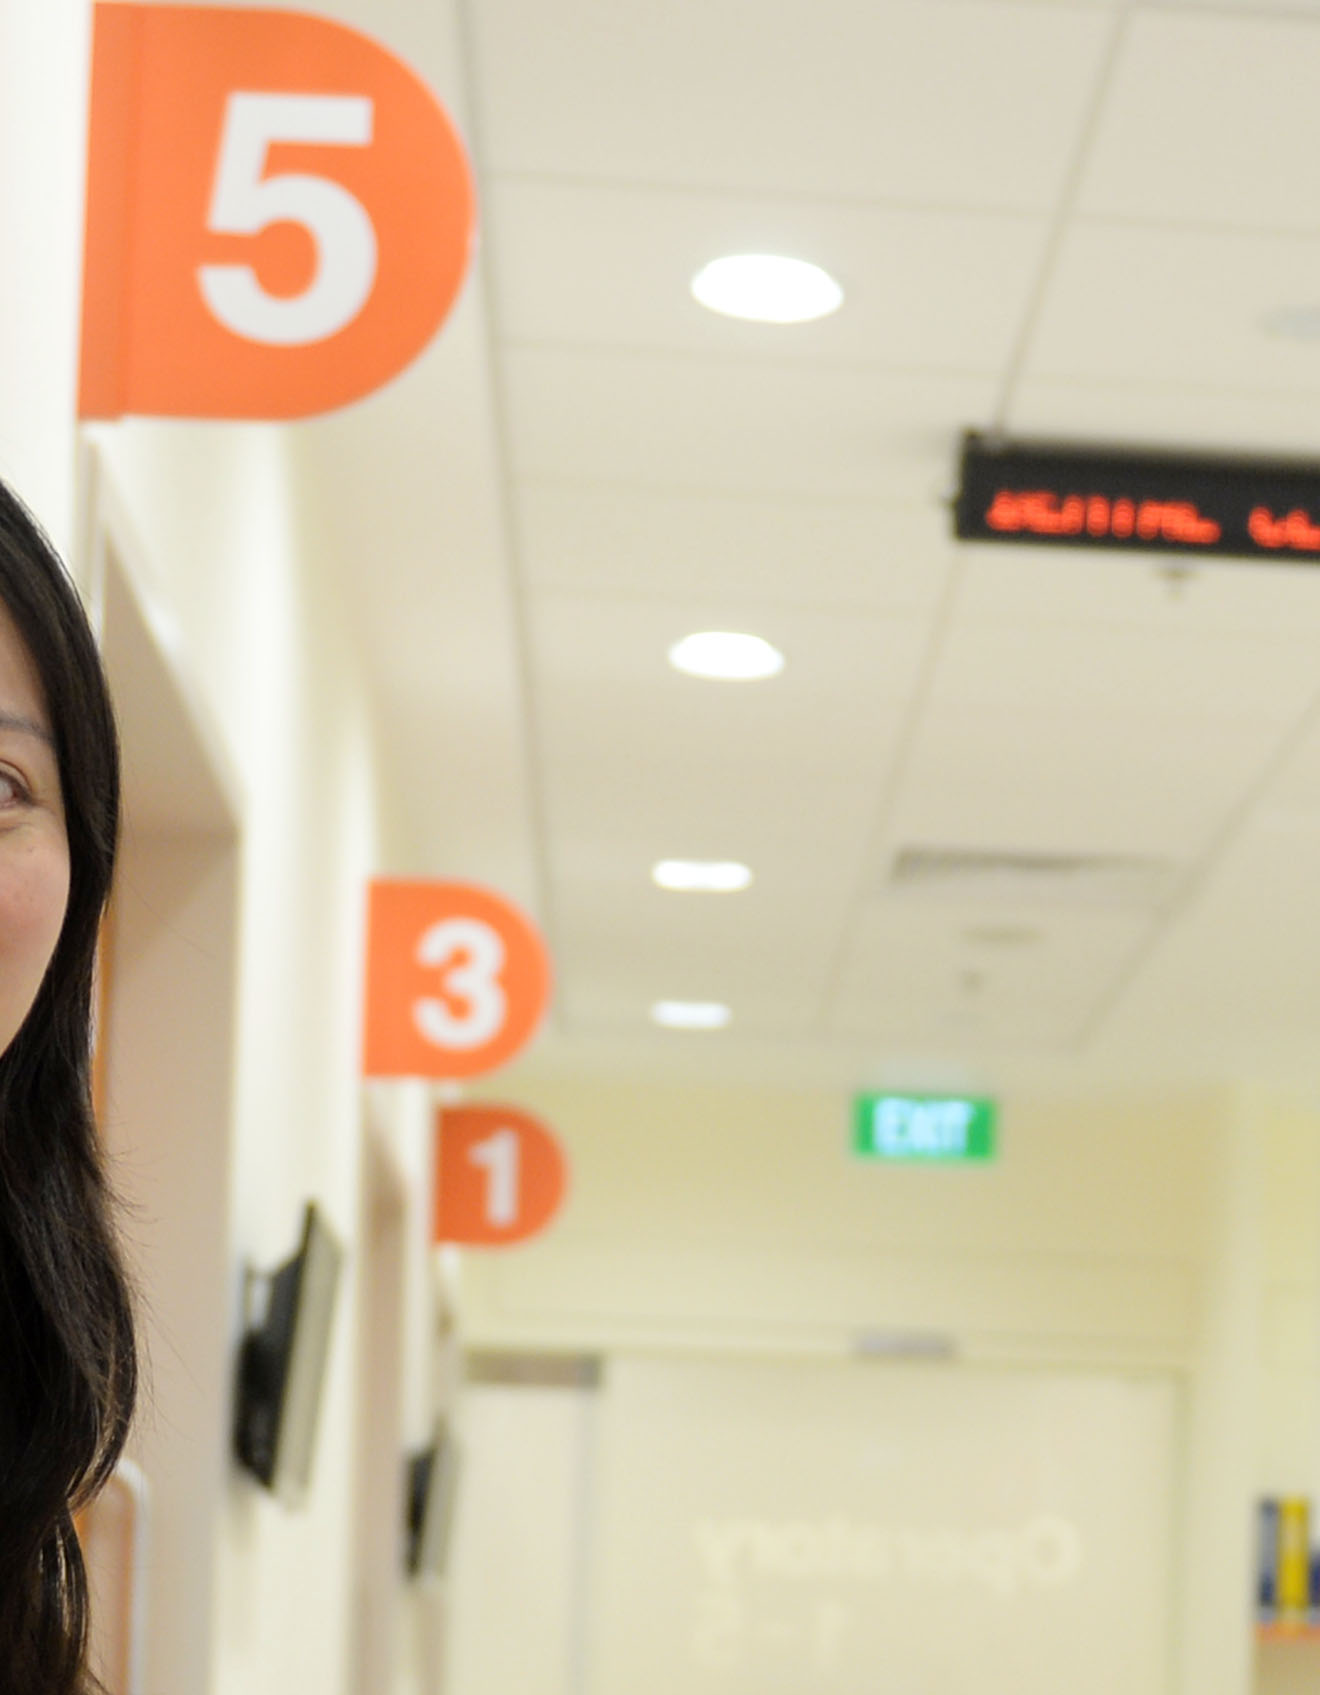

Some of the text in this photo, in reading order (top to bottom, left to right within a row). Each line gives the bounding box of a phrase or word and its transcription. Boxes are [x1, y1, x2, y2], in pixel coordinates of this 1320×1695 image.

[196, 91, 378, 346] 5
[413, 917, 506, 1052] 3
[468, 1129, 519, 1229] 1
[873, 1097, 976, 1157] EXIT
